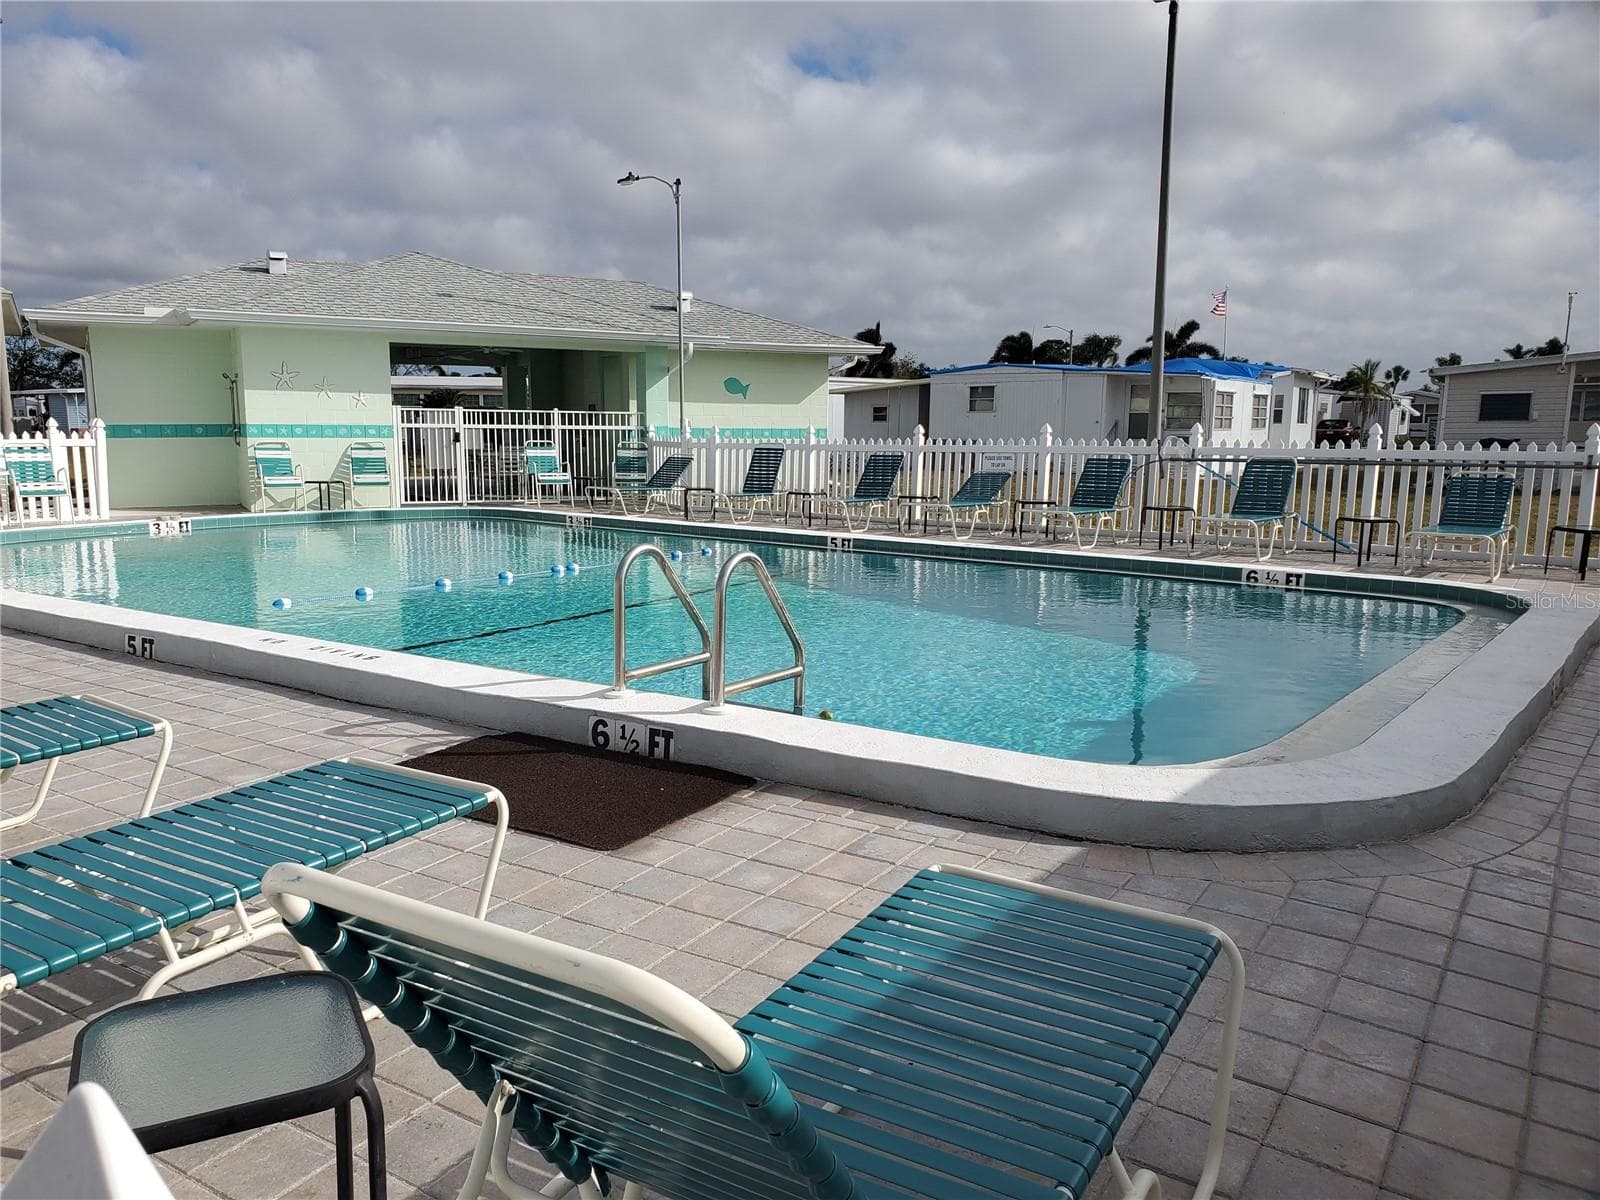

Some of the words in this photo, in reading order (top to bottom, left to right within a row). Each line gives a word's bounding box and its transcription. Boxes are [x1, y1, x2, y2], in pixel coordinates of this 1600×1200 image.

[153, 523, 161, 534] 3
[179, 521, 190, 533] FT
[831, 538, 838, 550] 5
[841, 539, 851, 551] FT
[1246, 570, 1259, 586] 6
[1285, 573, 1303, 590] FT
[127, 635, 136, 656] 5
[141, 637, 155, 659] FT
[307, 645, 382, 661] DIVING
[591, 718, 610, 751] 6
[647, 727, 674, 760] FT
